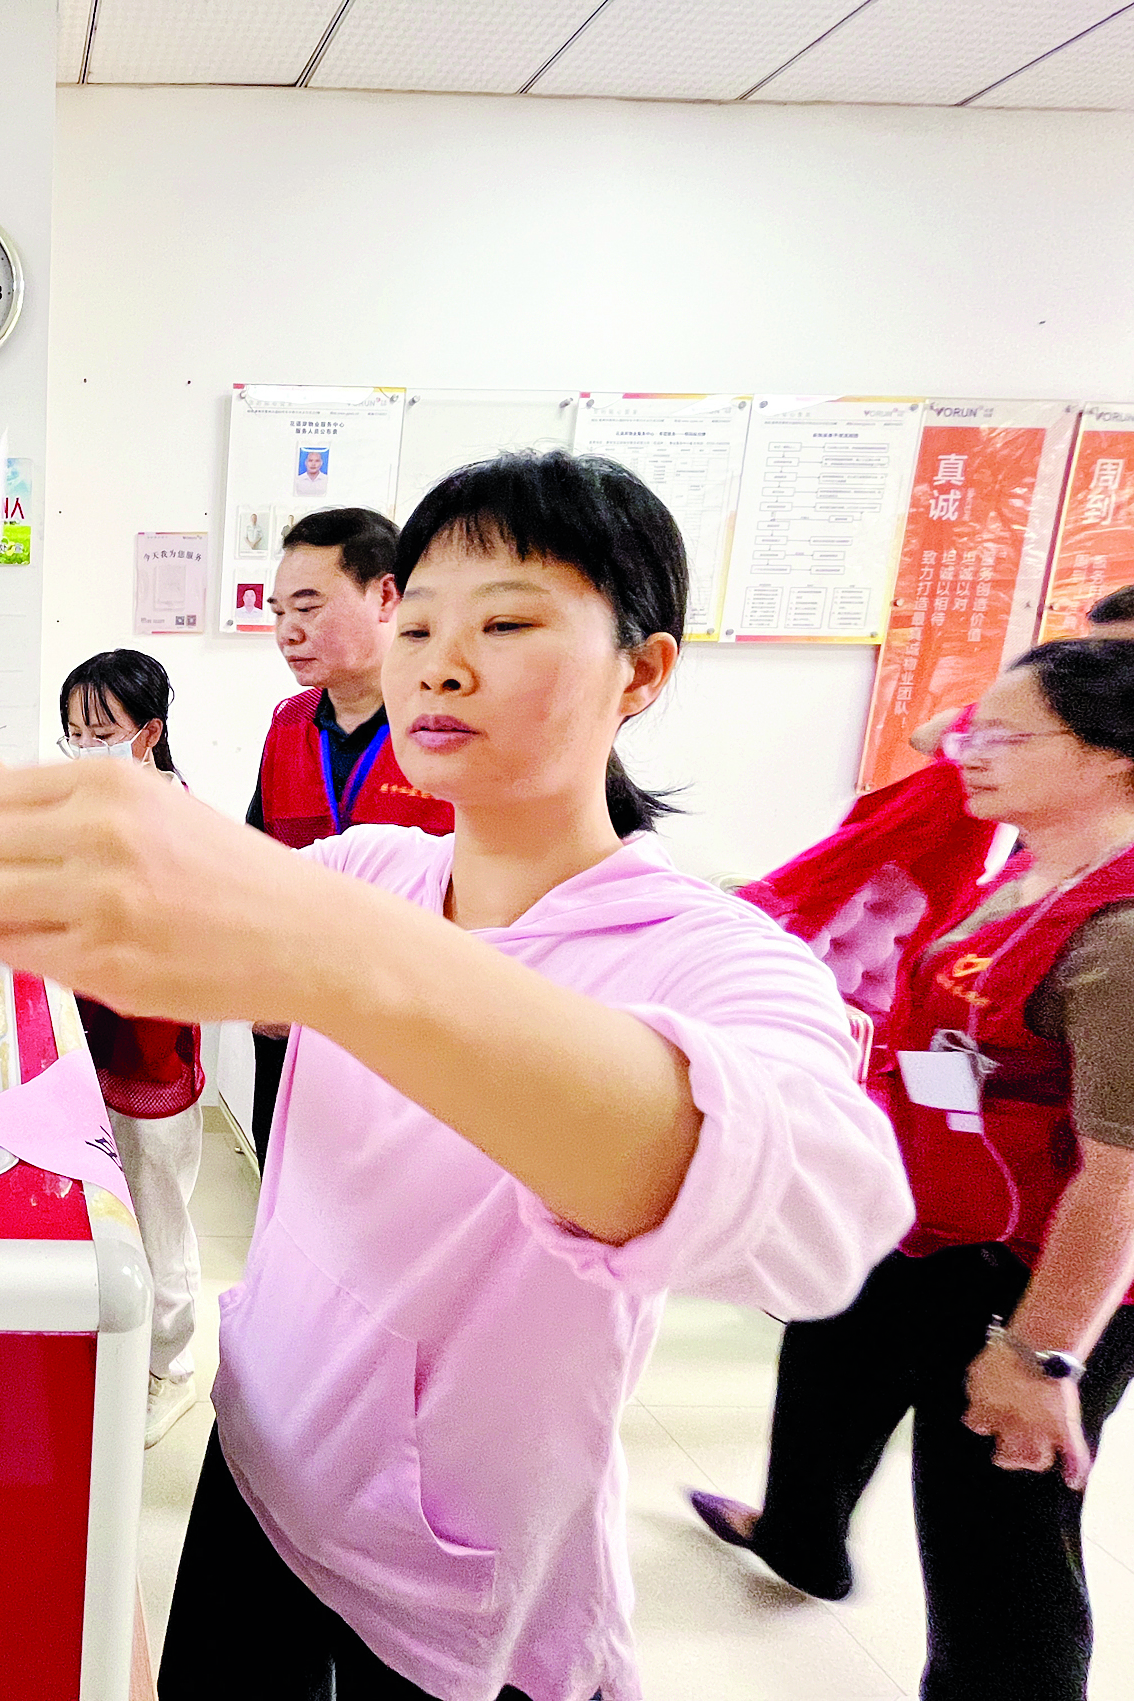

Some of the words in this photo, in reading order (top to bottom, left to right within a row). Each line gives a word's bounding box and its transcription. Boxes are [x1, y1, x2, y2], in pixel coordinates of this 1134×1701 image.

[935, 407, 978, 418] VORUN
[929, 453, 968, 521] 真诚
[1082, 459, 1126, 526] 周到
